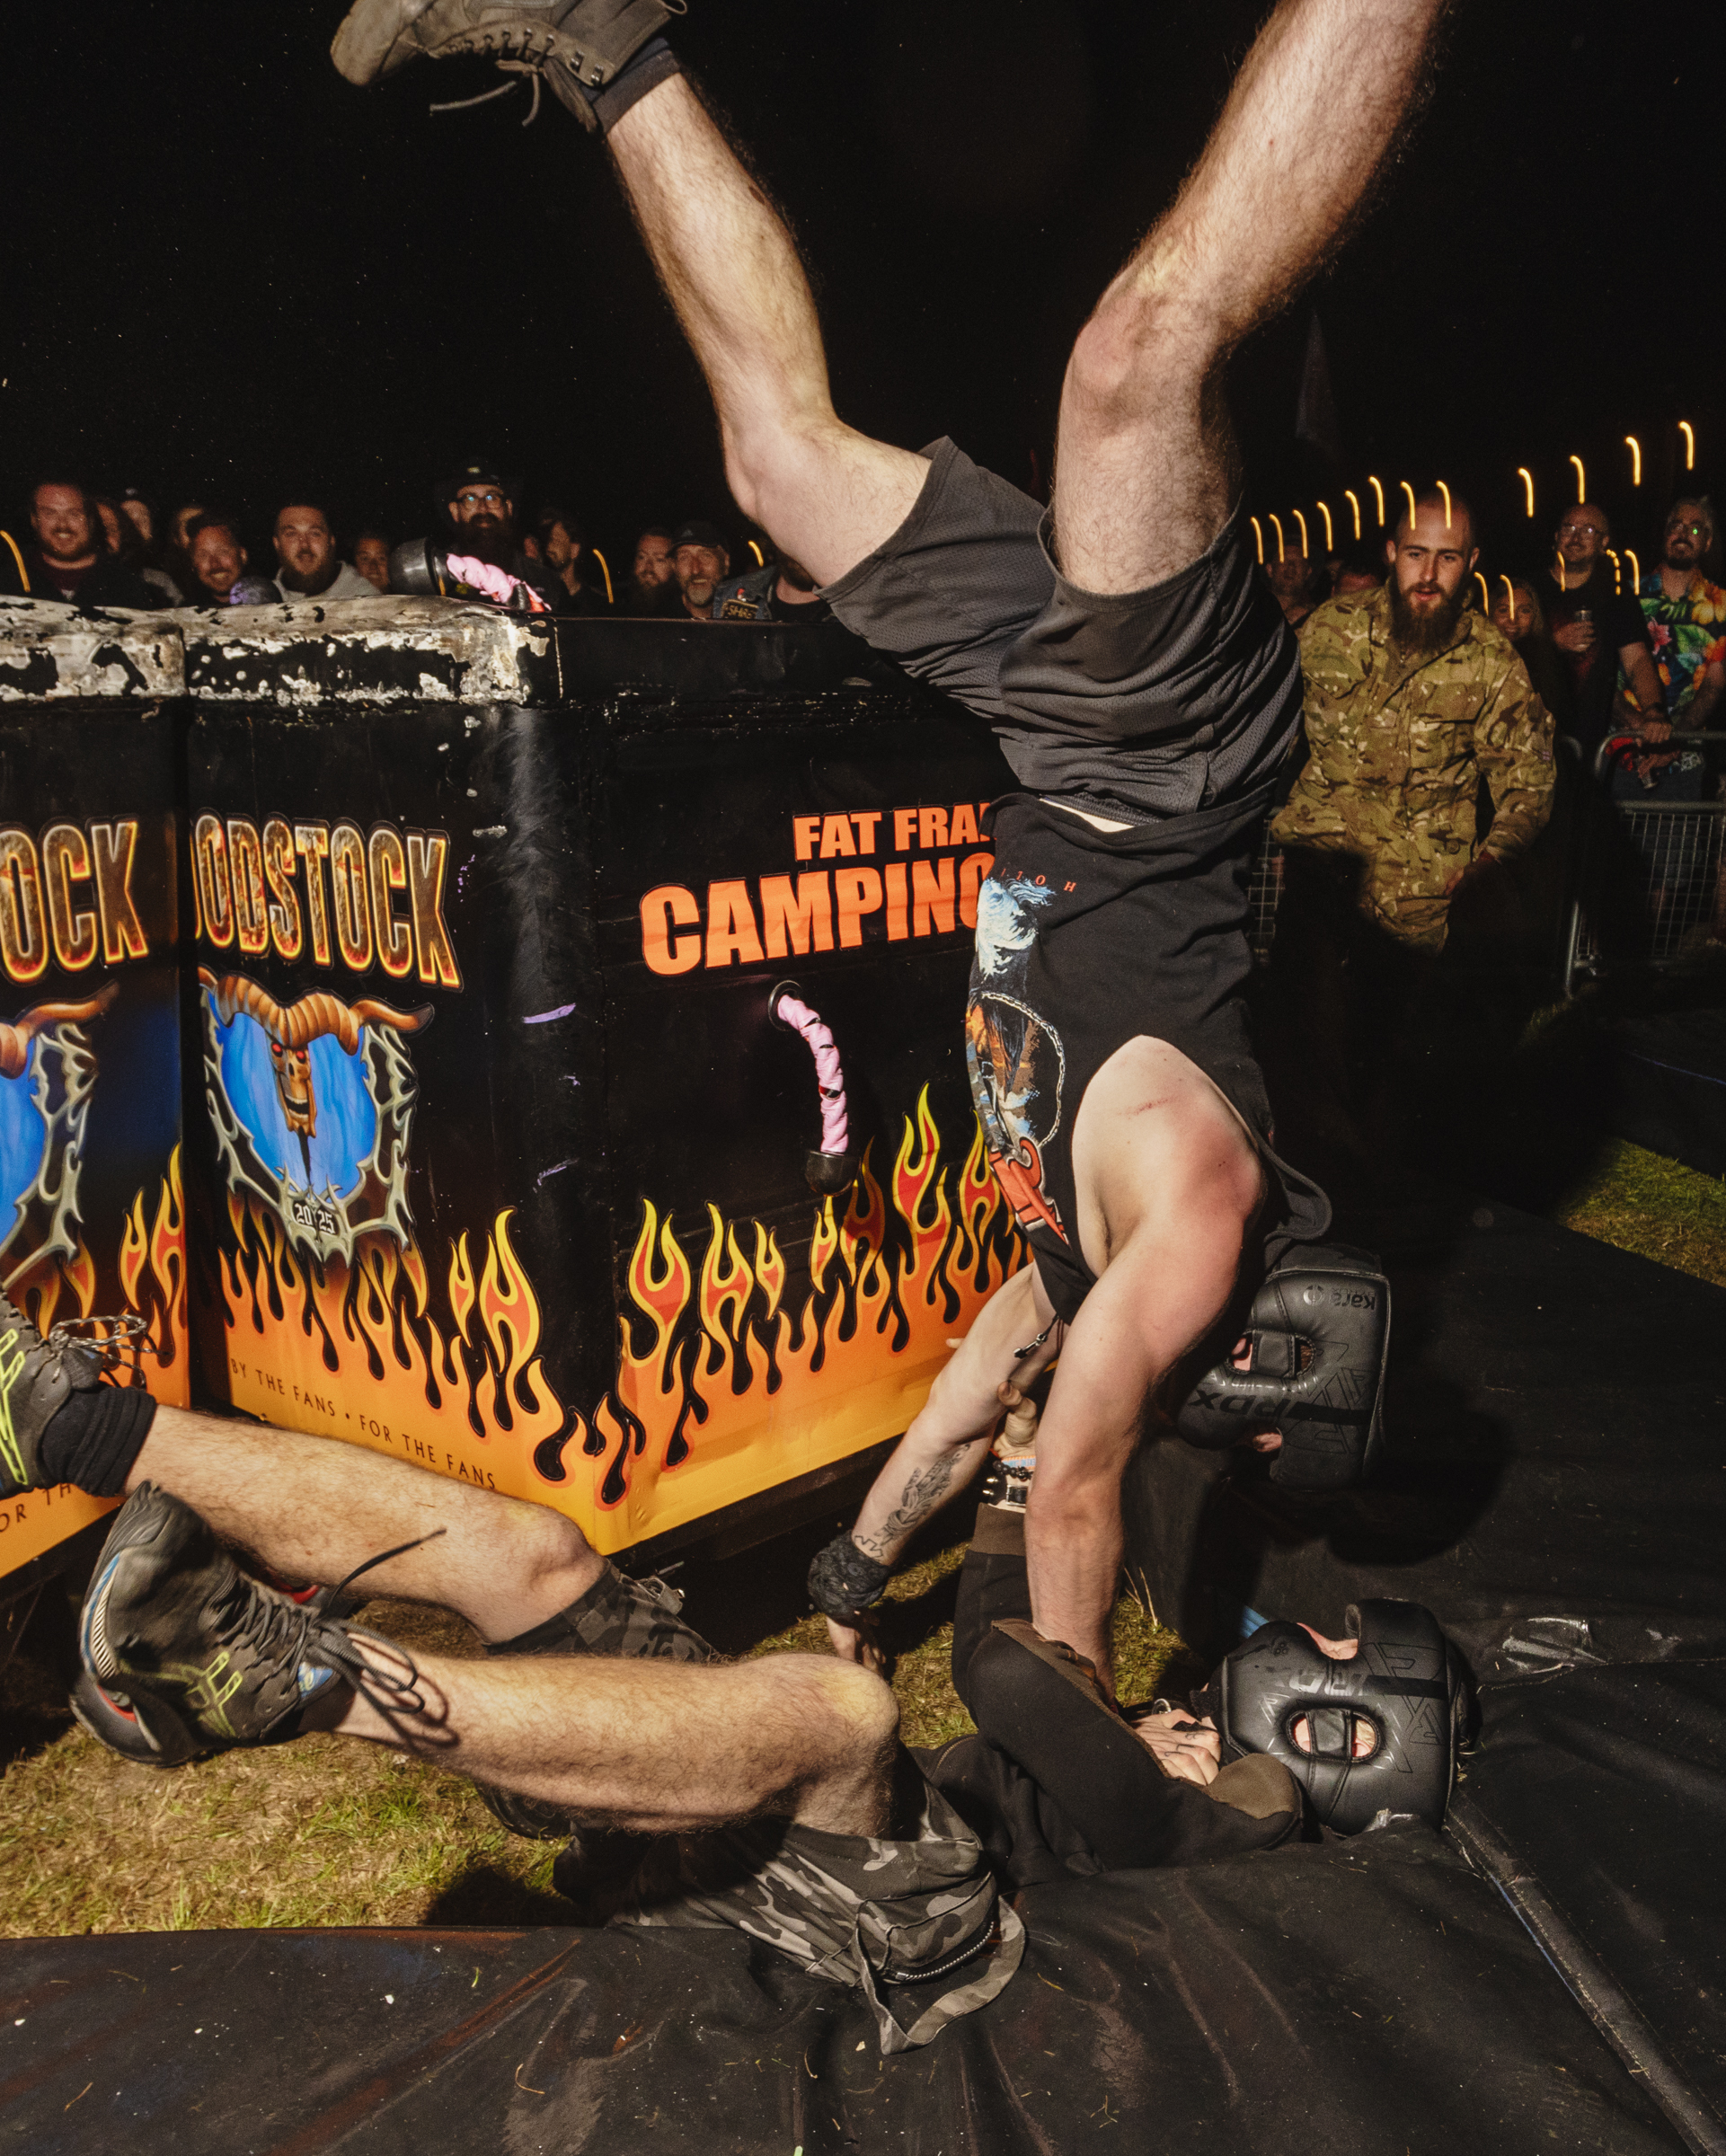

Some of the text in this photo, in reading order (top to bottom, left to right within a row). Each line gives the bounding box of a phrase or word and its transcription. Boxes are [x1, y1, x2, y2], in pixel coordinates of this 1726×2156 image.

[0, 821, 149, 983] OCK
[190, 814, 461, 989] ODSTOCK
[794, 802, 997, 862] FAT FRA
[230, 1357, 496, 1489] BY THE FANS FOR THE FANS
